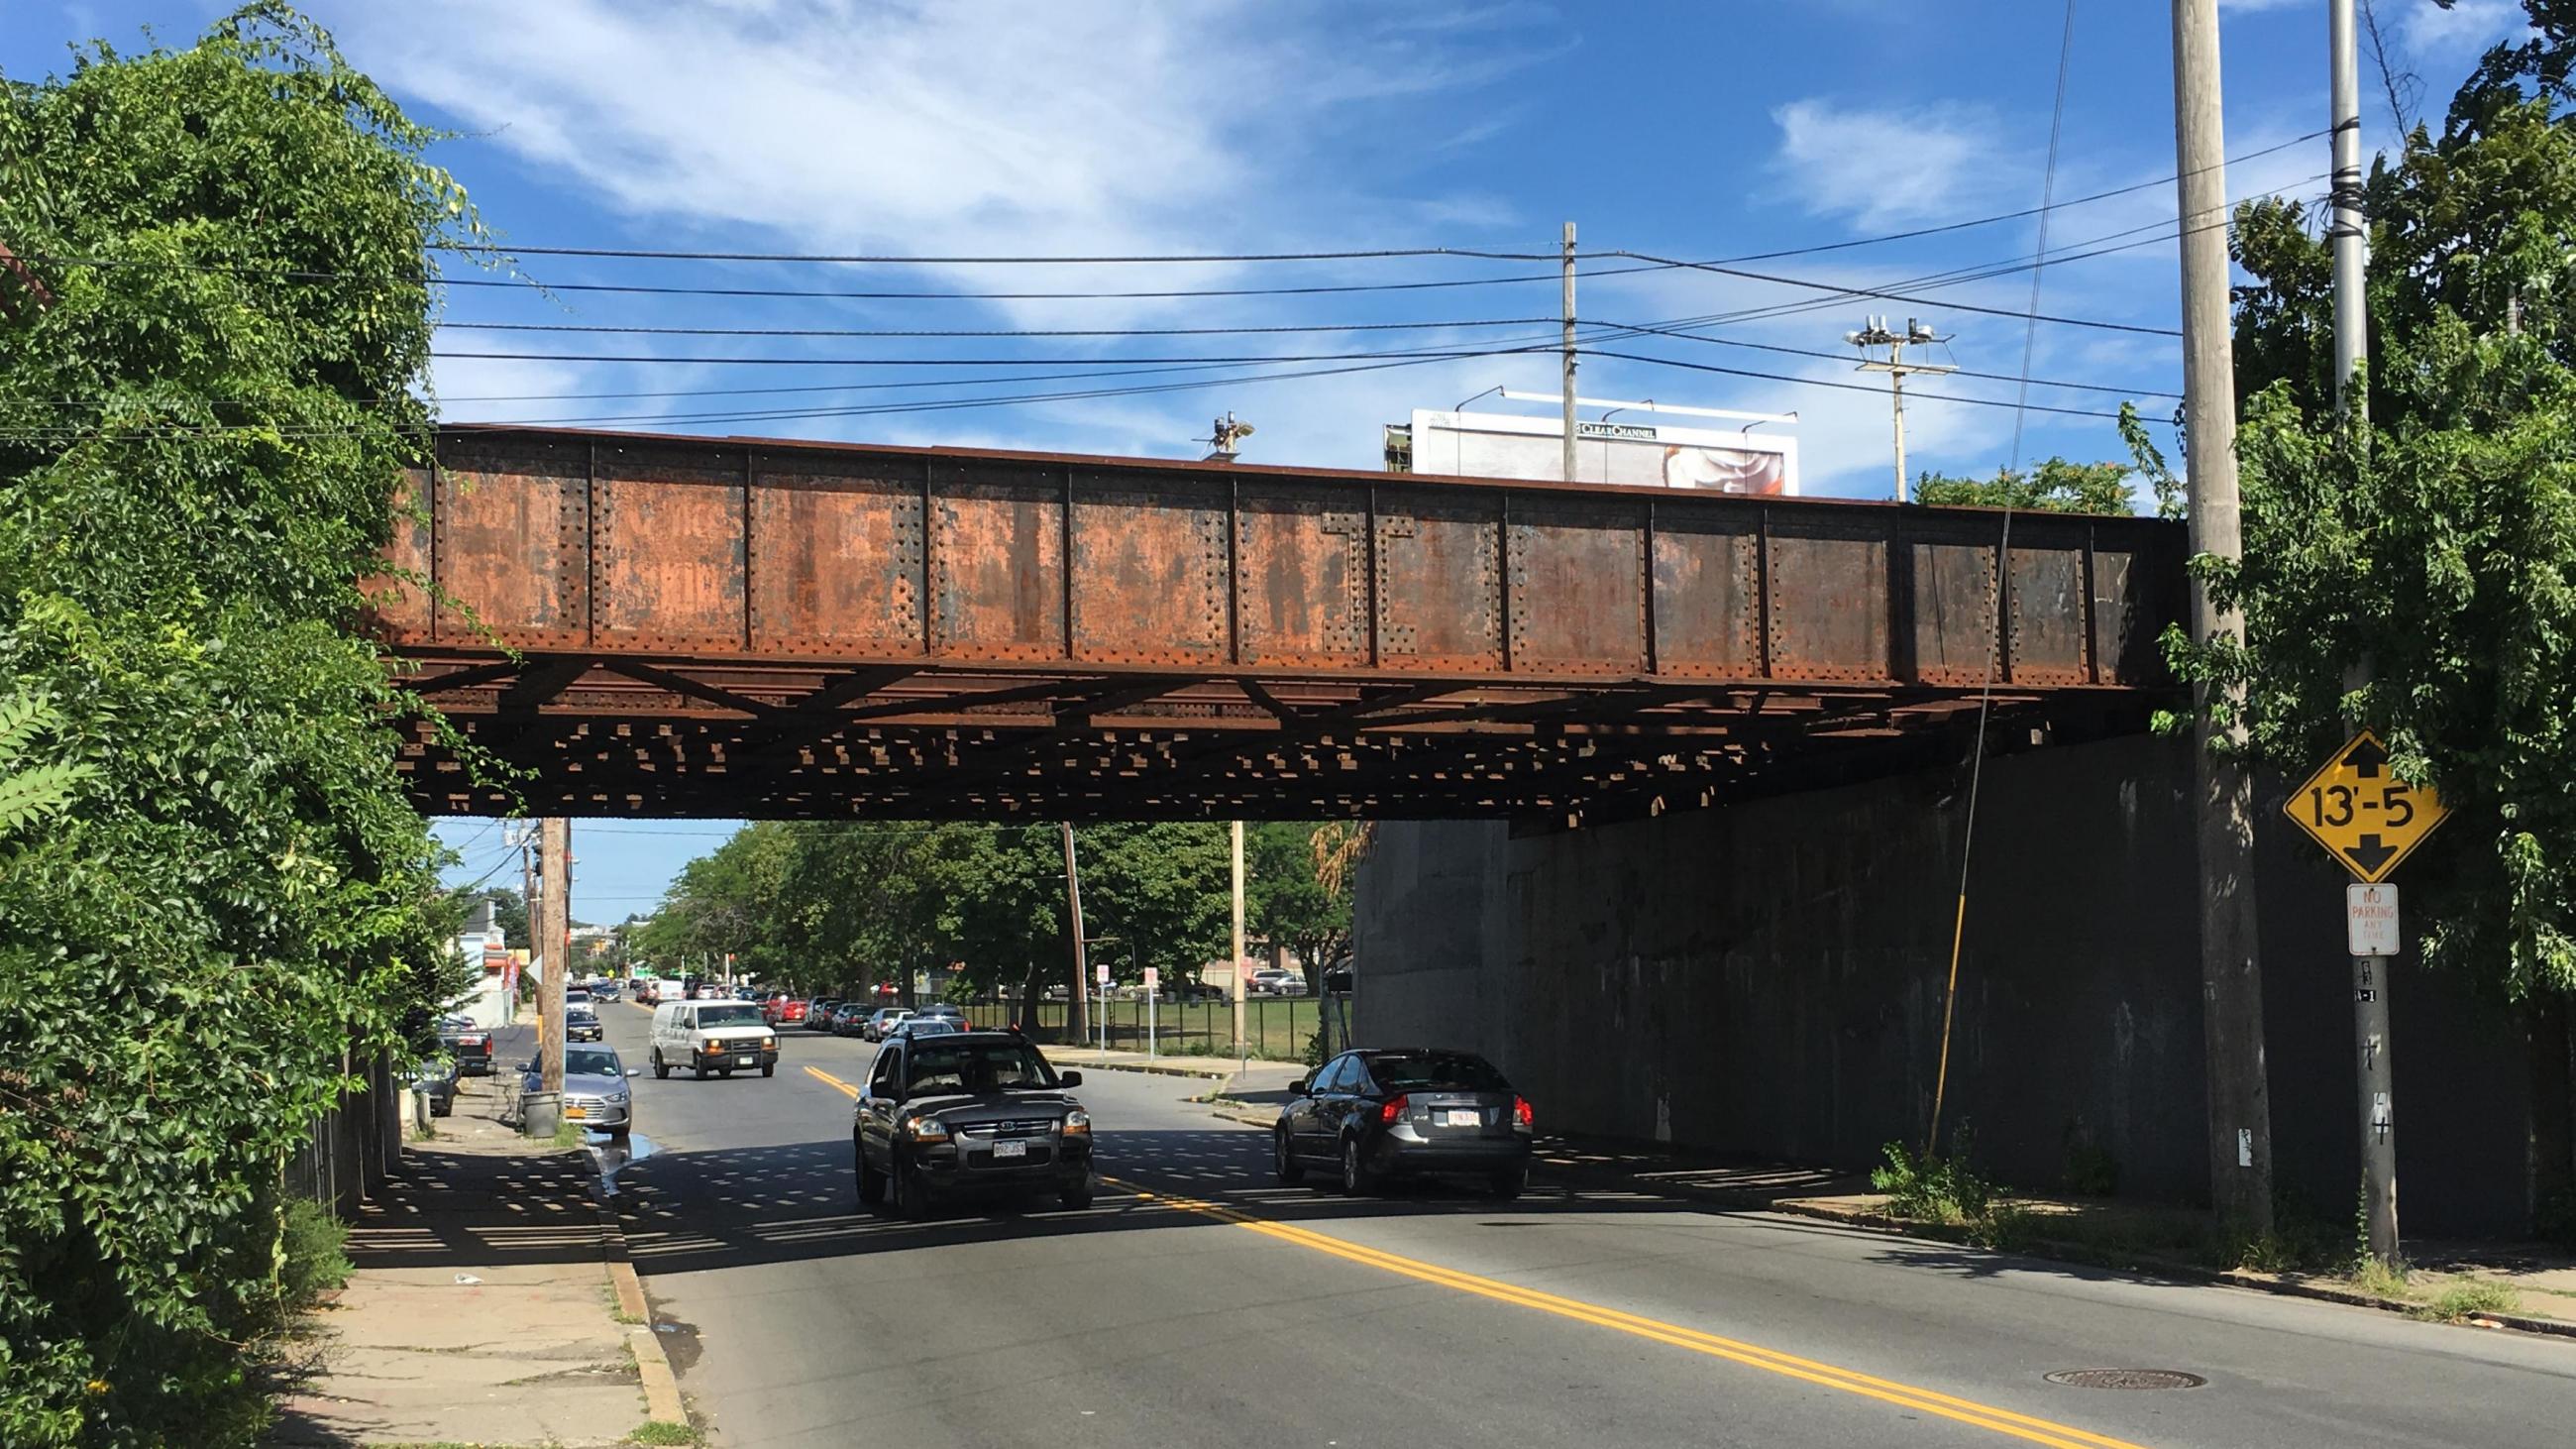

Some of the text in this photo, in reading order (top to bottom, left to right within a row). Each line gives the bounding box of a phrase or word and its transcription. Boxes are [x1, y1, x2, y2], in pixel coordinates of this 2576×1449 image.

[2363, 891, 2382, 903] NO
[2352, 906, 2394, 919] PARKING
[2364, 920, 2383, 929] ANY
